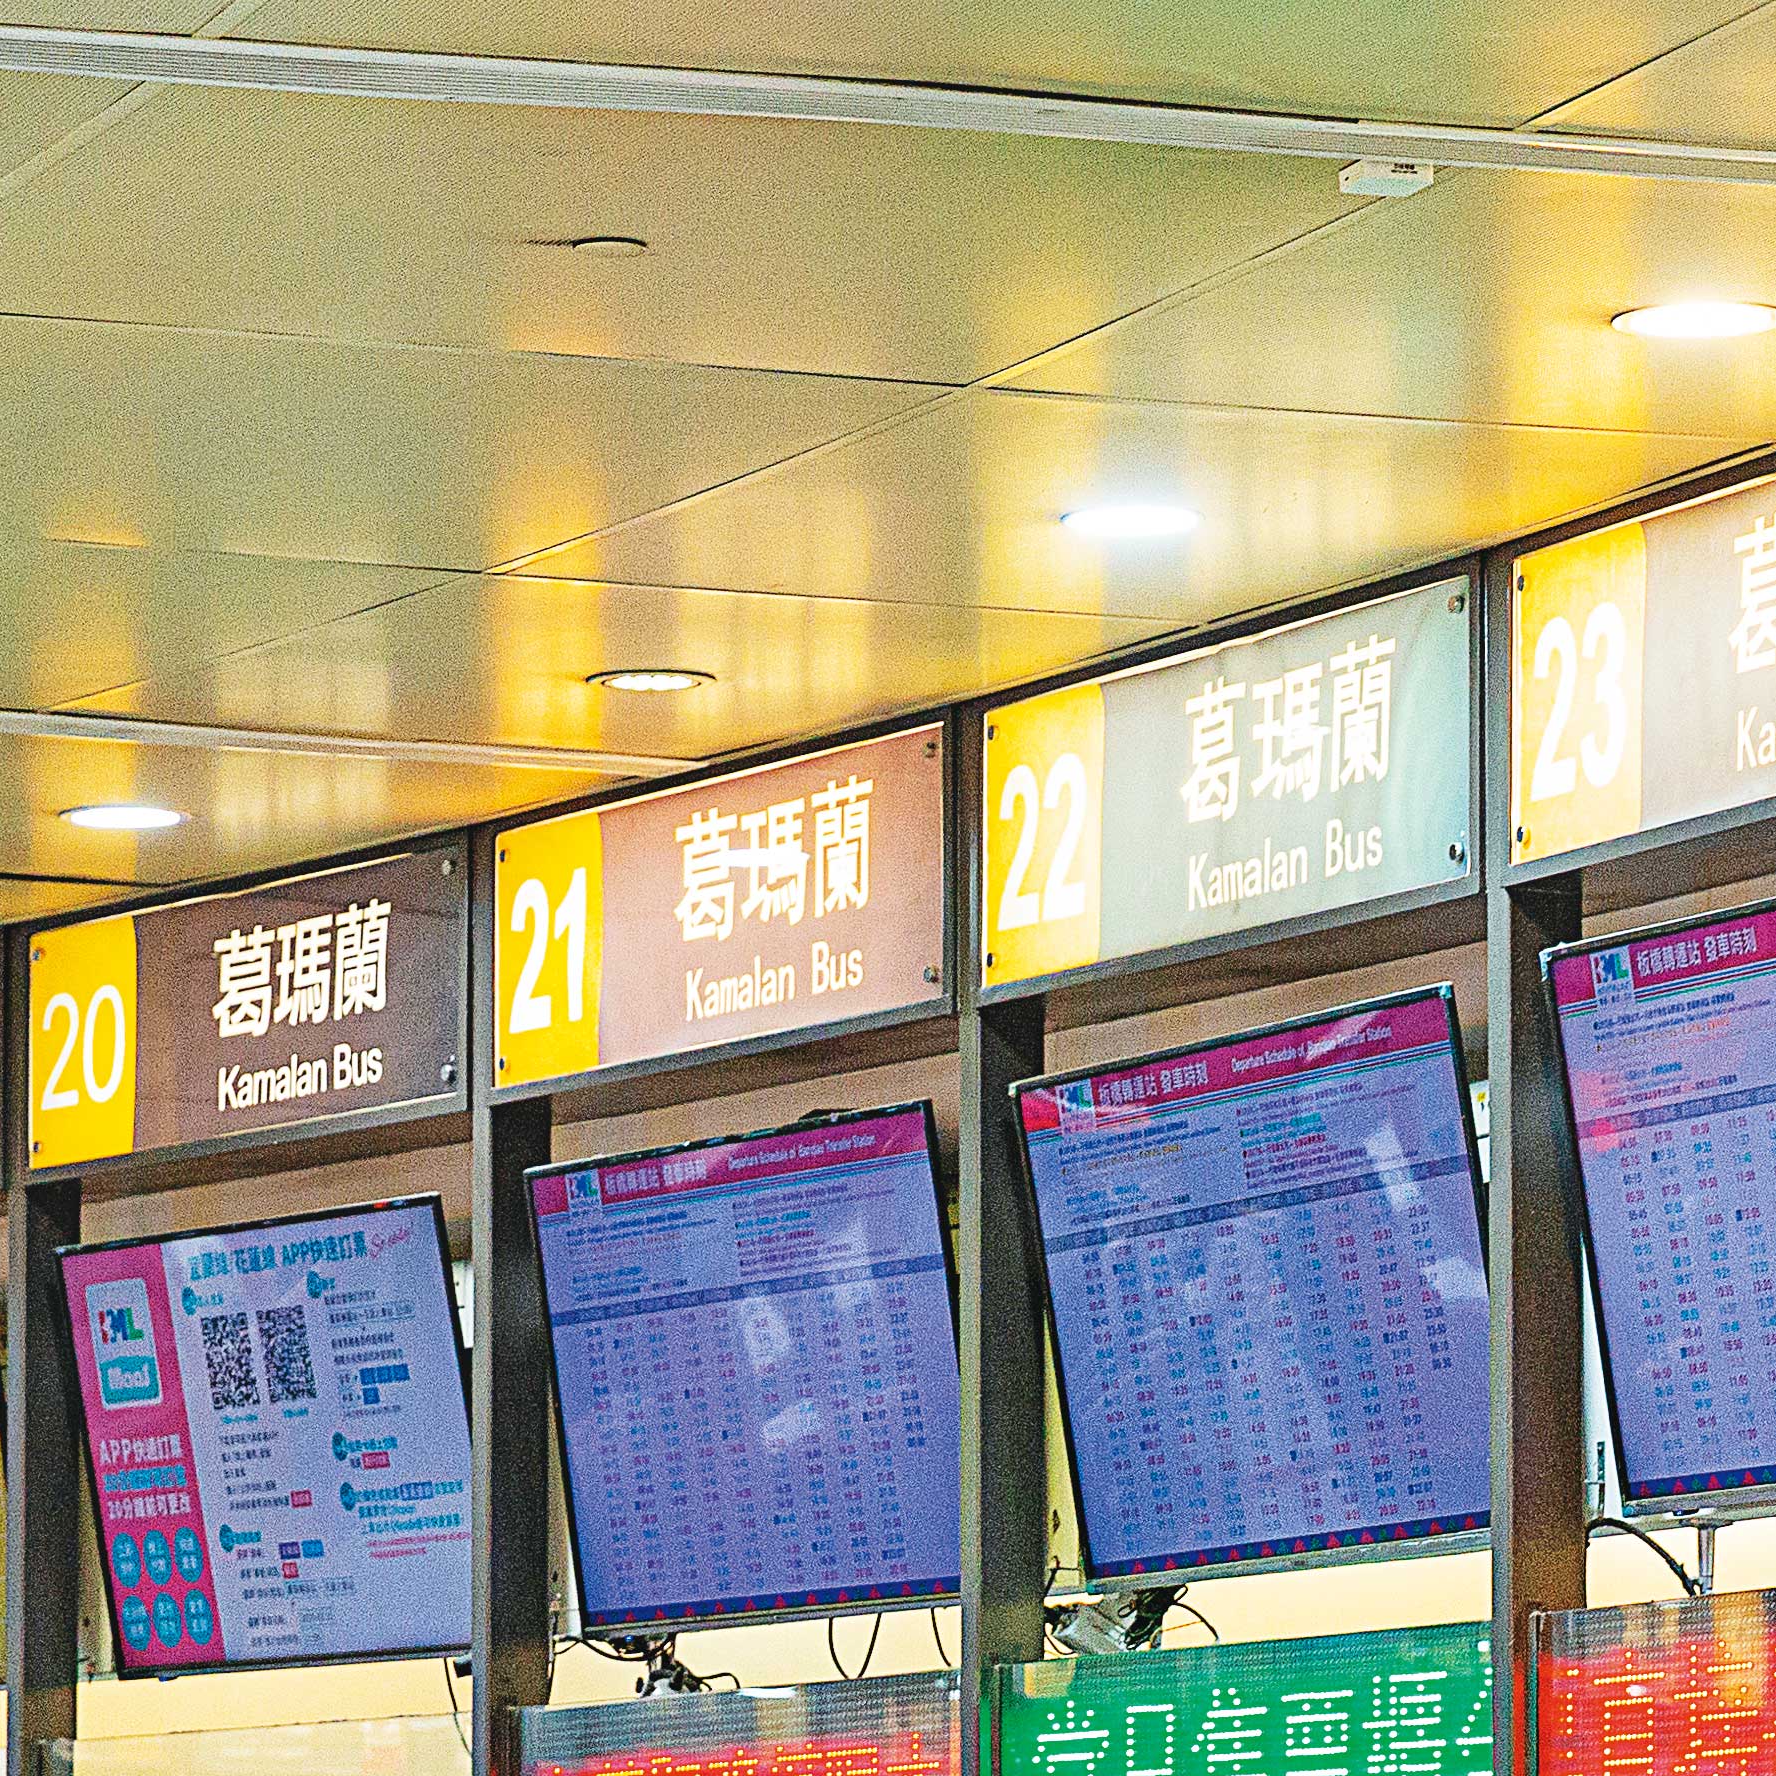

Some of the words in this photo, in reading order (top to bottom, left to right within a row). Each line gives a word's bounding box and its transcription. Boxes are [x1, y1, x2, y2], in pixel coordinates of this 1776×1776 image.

[1181, 633, 1396, 823] 葛瑪蘭
[1531, 601, 1624, 800] 23
[674, 774, 873, 944] 葛瑪蘭
[997, 753, 1086, 931] 22
[1187, 836, 1308, 911] Kamalan
[1324, 817, 1382, 878] Bus
[213, 897, 392, 1041] 葛瑪蘭
[509, 867, 585, 1035] 21
[686, 955, 797, 1023] Kamalan
[812, 942, 862, 994] Bus
[41, 984, 126, 1111] 20
[217, 1053, 327, 1113] Kamalan
[333, 1041, 383, 1094] Bus
